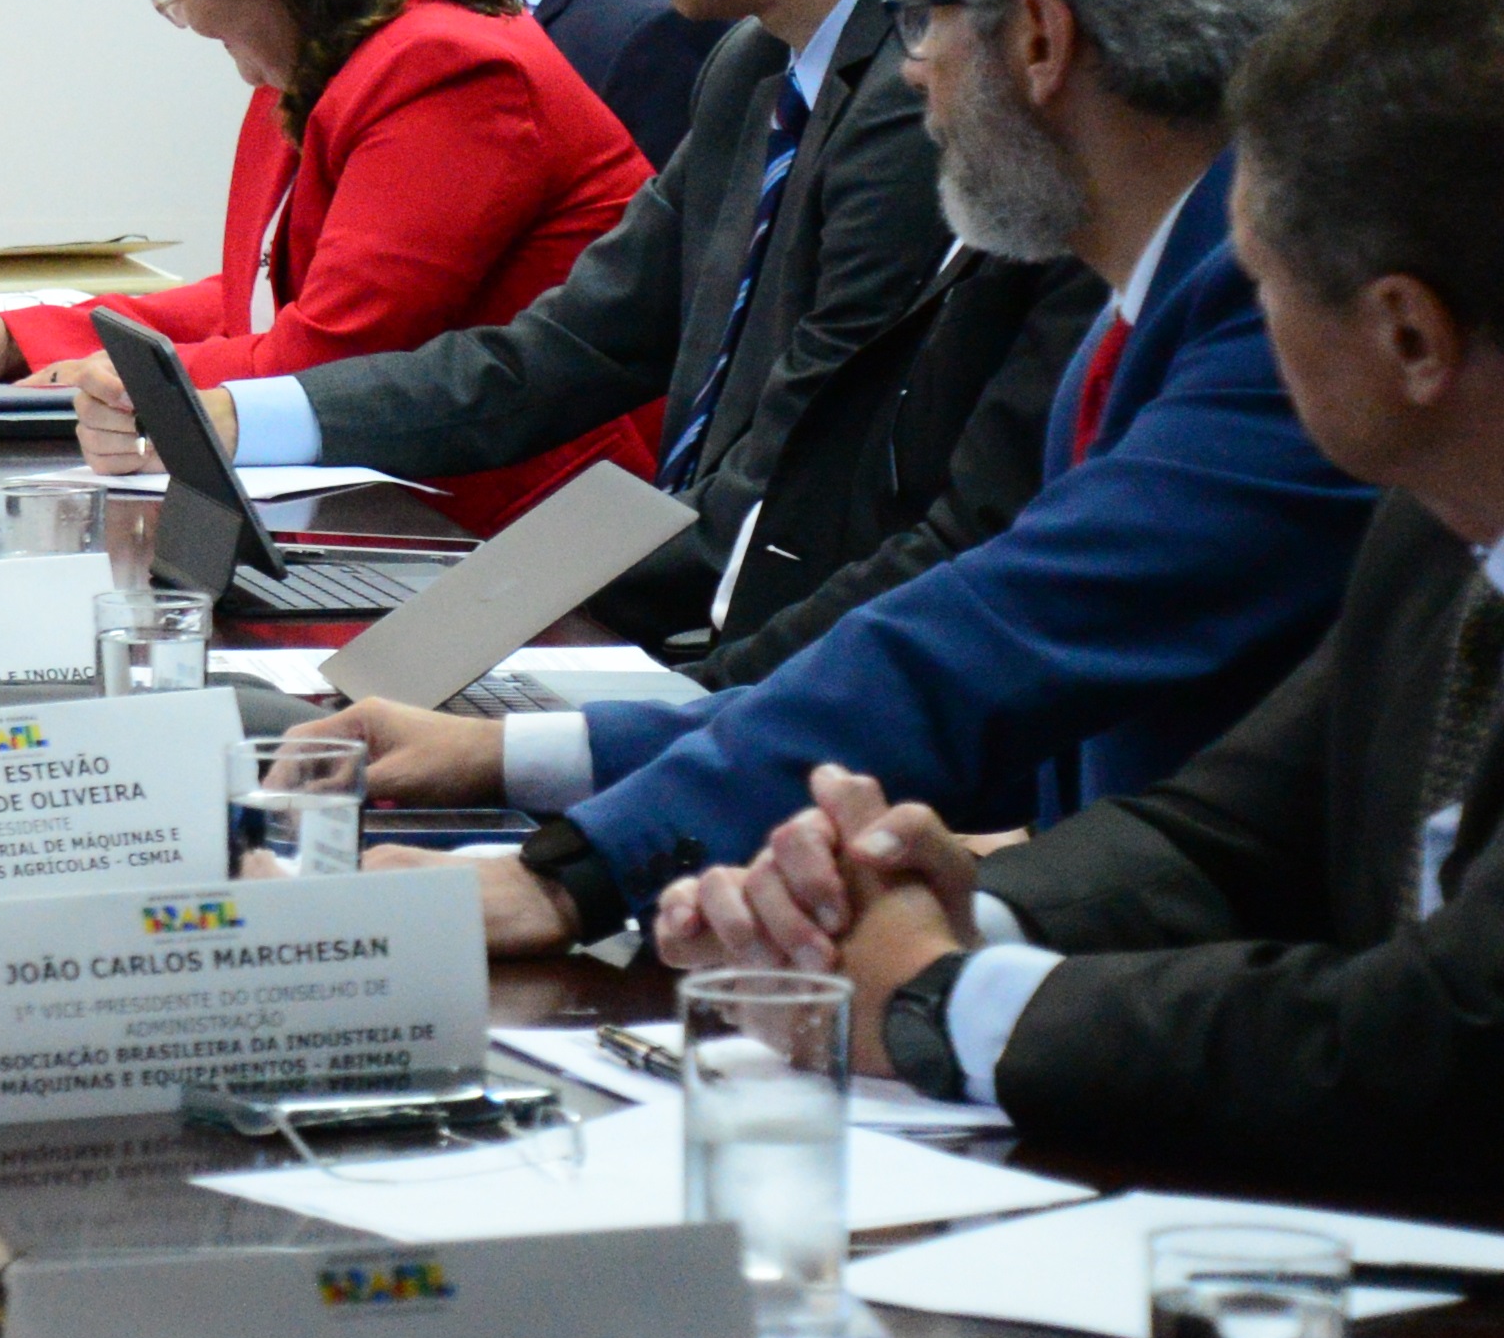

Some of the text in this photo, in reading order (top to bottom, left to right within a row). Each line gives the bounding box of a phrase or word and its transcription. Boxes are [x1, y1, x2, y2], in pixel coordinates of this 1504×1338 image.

[5, 753, 111, 785] ESTEVÃO
[30, 782, 147, 810] OLIVEIRA
[44, 839, 65, 853] DE
[72, 829, 166, 852] MÁQUINAS
[171, 827, 181, 841] E
[13, 855, 110, 878] AGRÍCOLAS
[128, 849, 183, 868] CSMIA
[141, 901, 246, 934] BRASIL
[5, 936, 391, 986] JOÃO CARLOS MARCHESAN
[219, 989, 248, 1007] DO
[254, 980, 359, 1004] CONSELHO
[364, 978, 391, 996] DE
[125, 1009, 284, 1039] ADMINISTRAÇÃO
[116, 1035, 244, 1062] BRASILEIRA
[249, 1036, 279, 1054] DA
[286, 1026, 405, 1050] INDÚSTRIA
[410, 1023, 435, 1041] DE
[0, 1072, 116, 1098] MÁQUINAS
[121, 1072, 132, 1087] E
